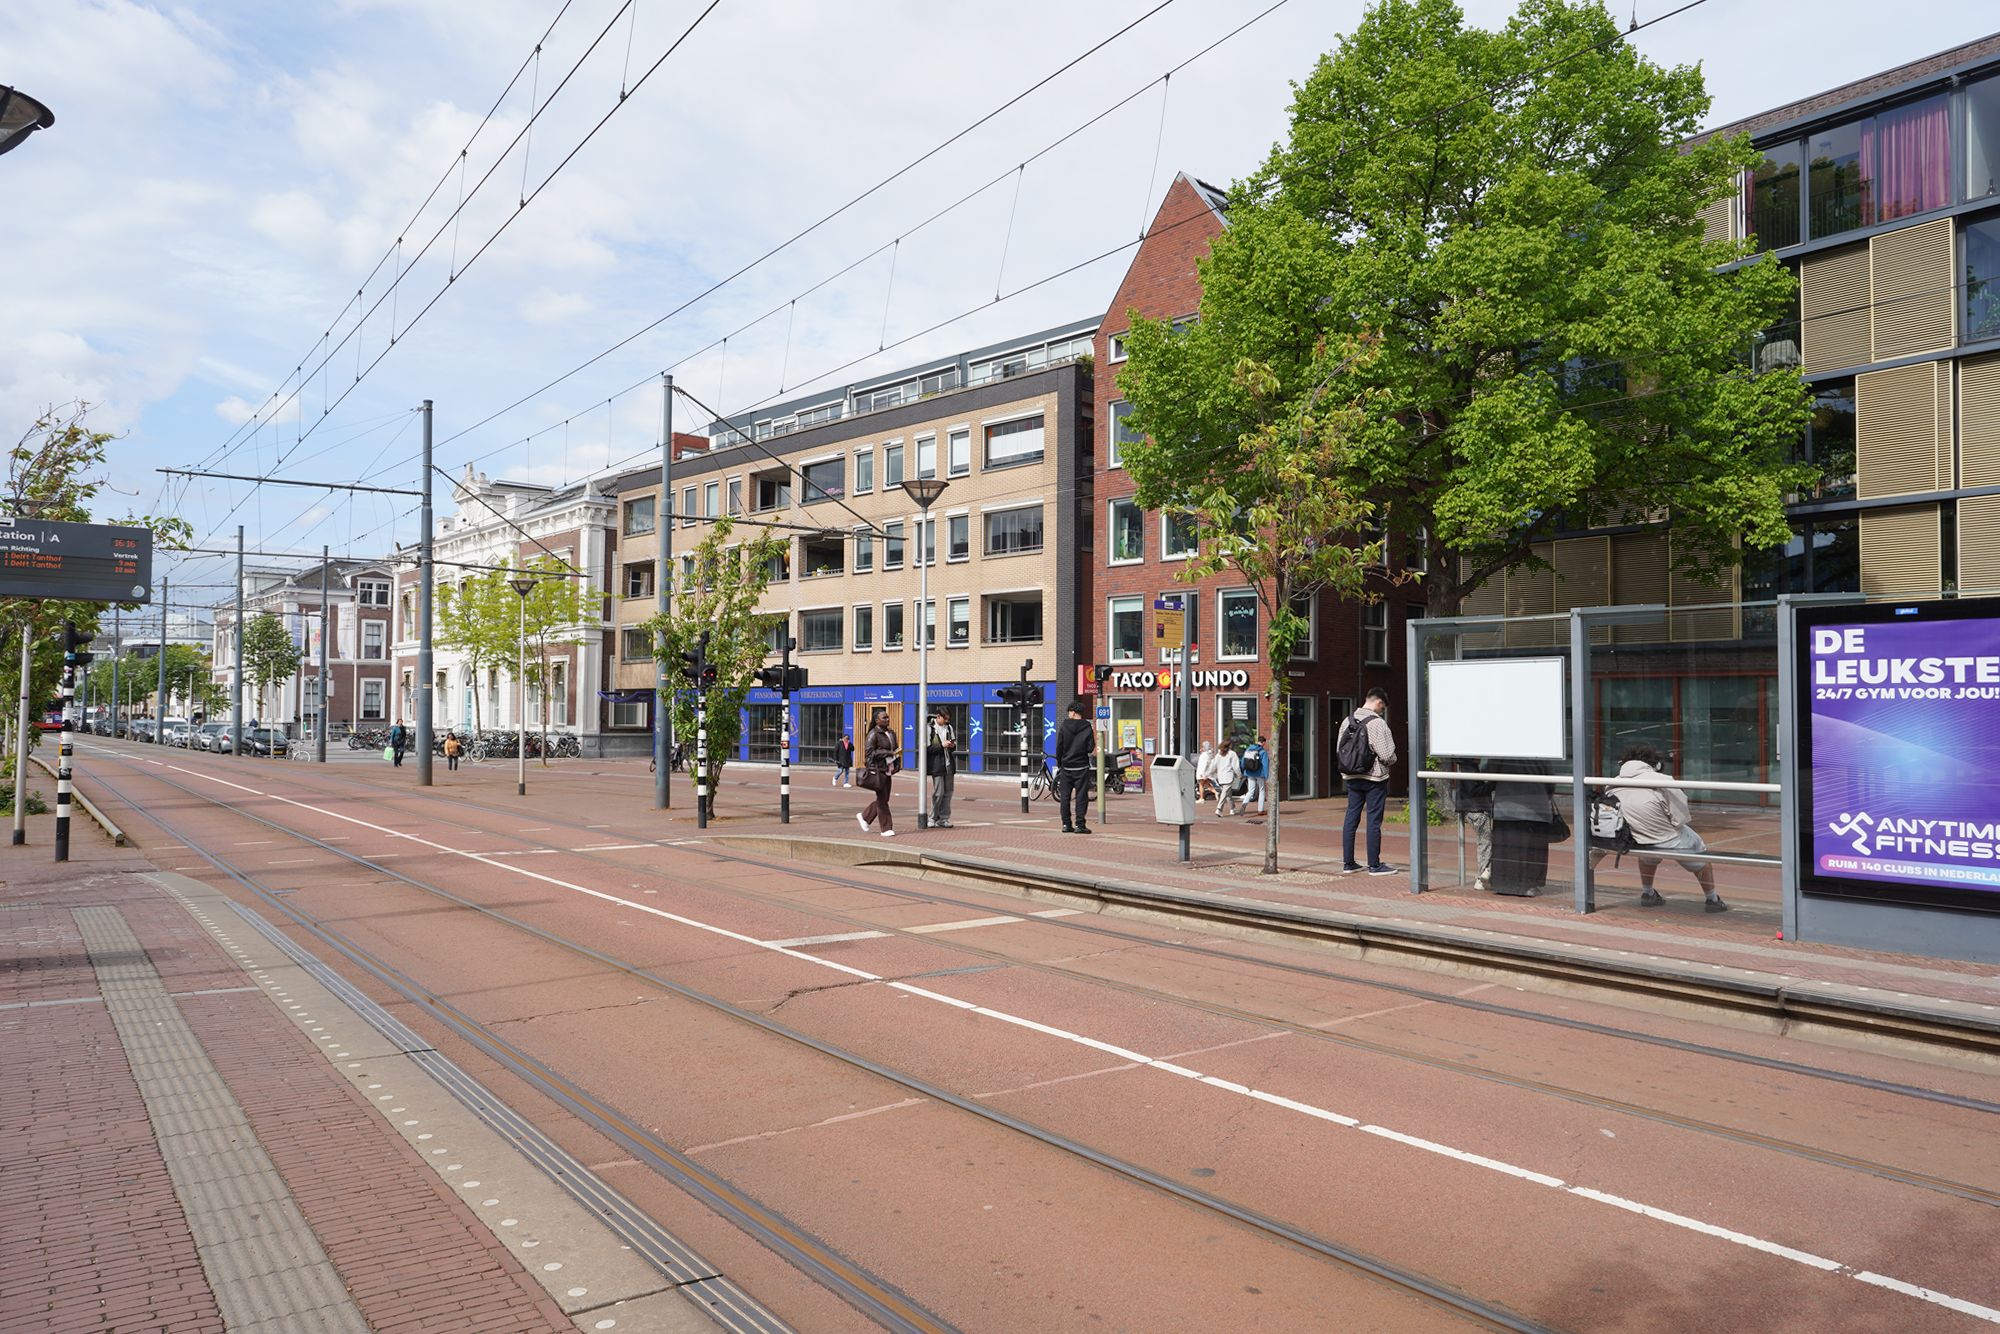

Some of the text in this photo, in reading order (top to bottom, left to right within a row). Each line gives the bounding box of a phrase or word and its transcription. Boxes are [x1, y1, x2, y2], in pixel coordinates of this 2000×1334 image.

[50, 534, 60, 543] A
[11, 545, 40, 554] Richting
[1815, 628, 1865, 654] DE
[1111, 671, 1155, 688] TACO
[1815, 656, 2000, 684] LEUKSTE
[1816, 687, 2000, 700] 24/7 GYM VOOR JOU!
[1876, 817, 2000, 840] ANYTIM
[1828, 859, 2000, 882] RUIM 140 CLUBS IN NEDERLA
